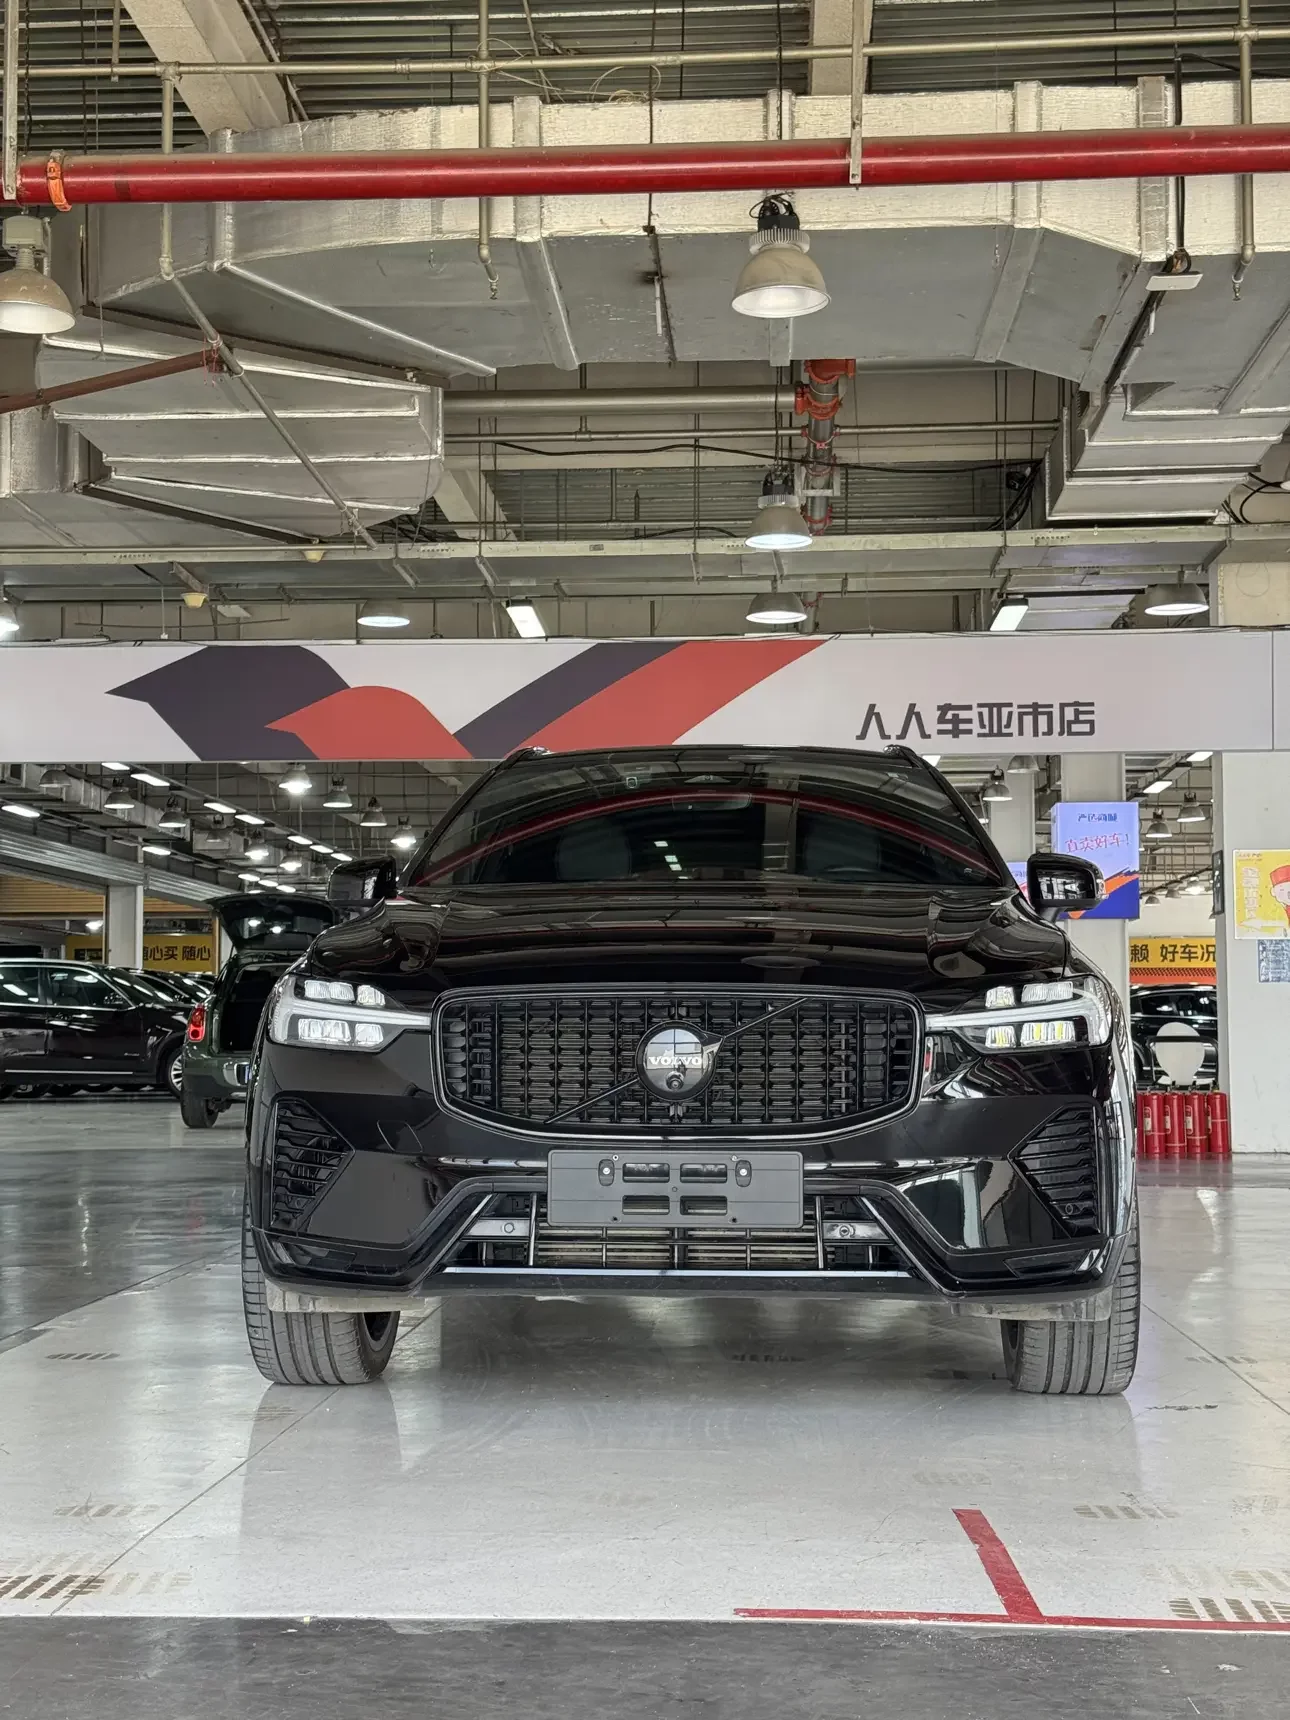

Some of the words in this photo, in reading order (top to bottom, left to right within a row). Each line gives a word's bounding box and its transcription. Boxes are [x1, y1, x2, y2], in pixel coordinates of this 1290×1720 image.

[855, 701, 1096, 740] 人人车亚市店
[182, 946, 211, 961] 随心
[1130, 944, 1149, 962] 赖
[648, 1056, 703, 1067] VOLVO
